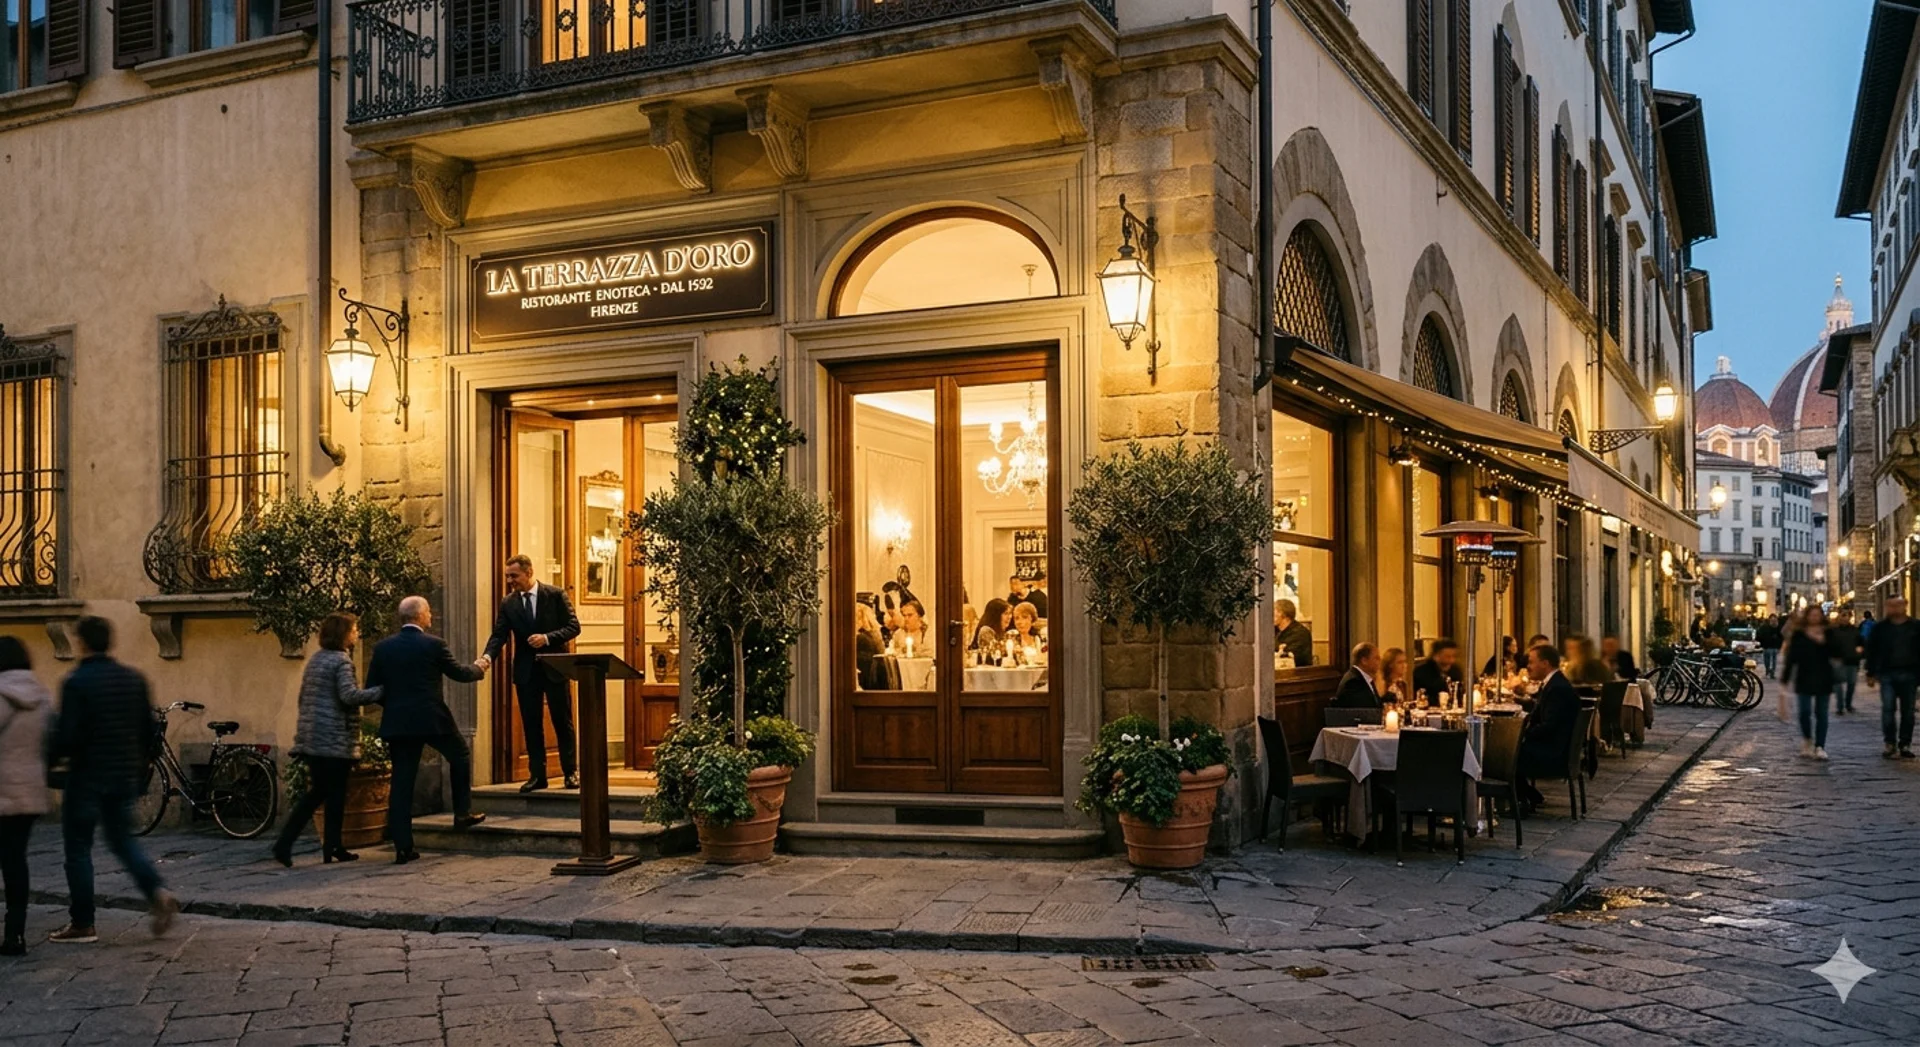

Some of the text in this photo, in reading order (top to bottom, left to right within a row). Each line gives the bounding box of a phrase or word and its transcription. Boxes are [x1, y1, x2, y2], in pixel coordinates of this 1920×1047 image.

[486, 239, 755, 295] LA TERRAZZA D'ORO
[521, 278, 713, 309] RISTORANTE ENOTECA DAL 1592
[591, 302, 638, 318] FIRENZE
